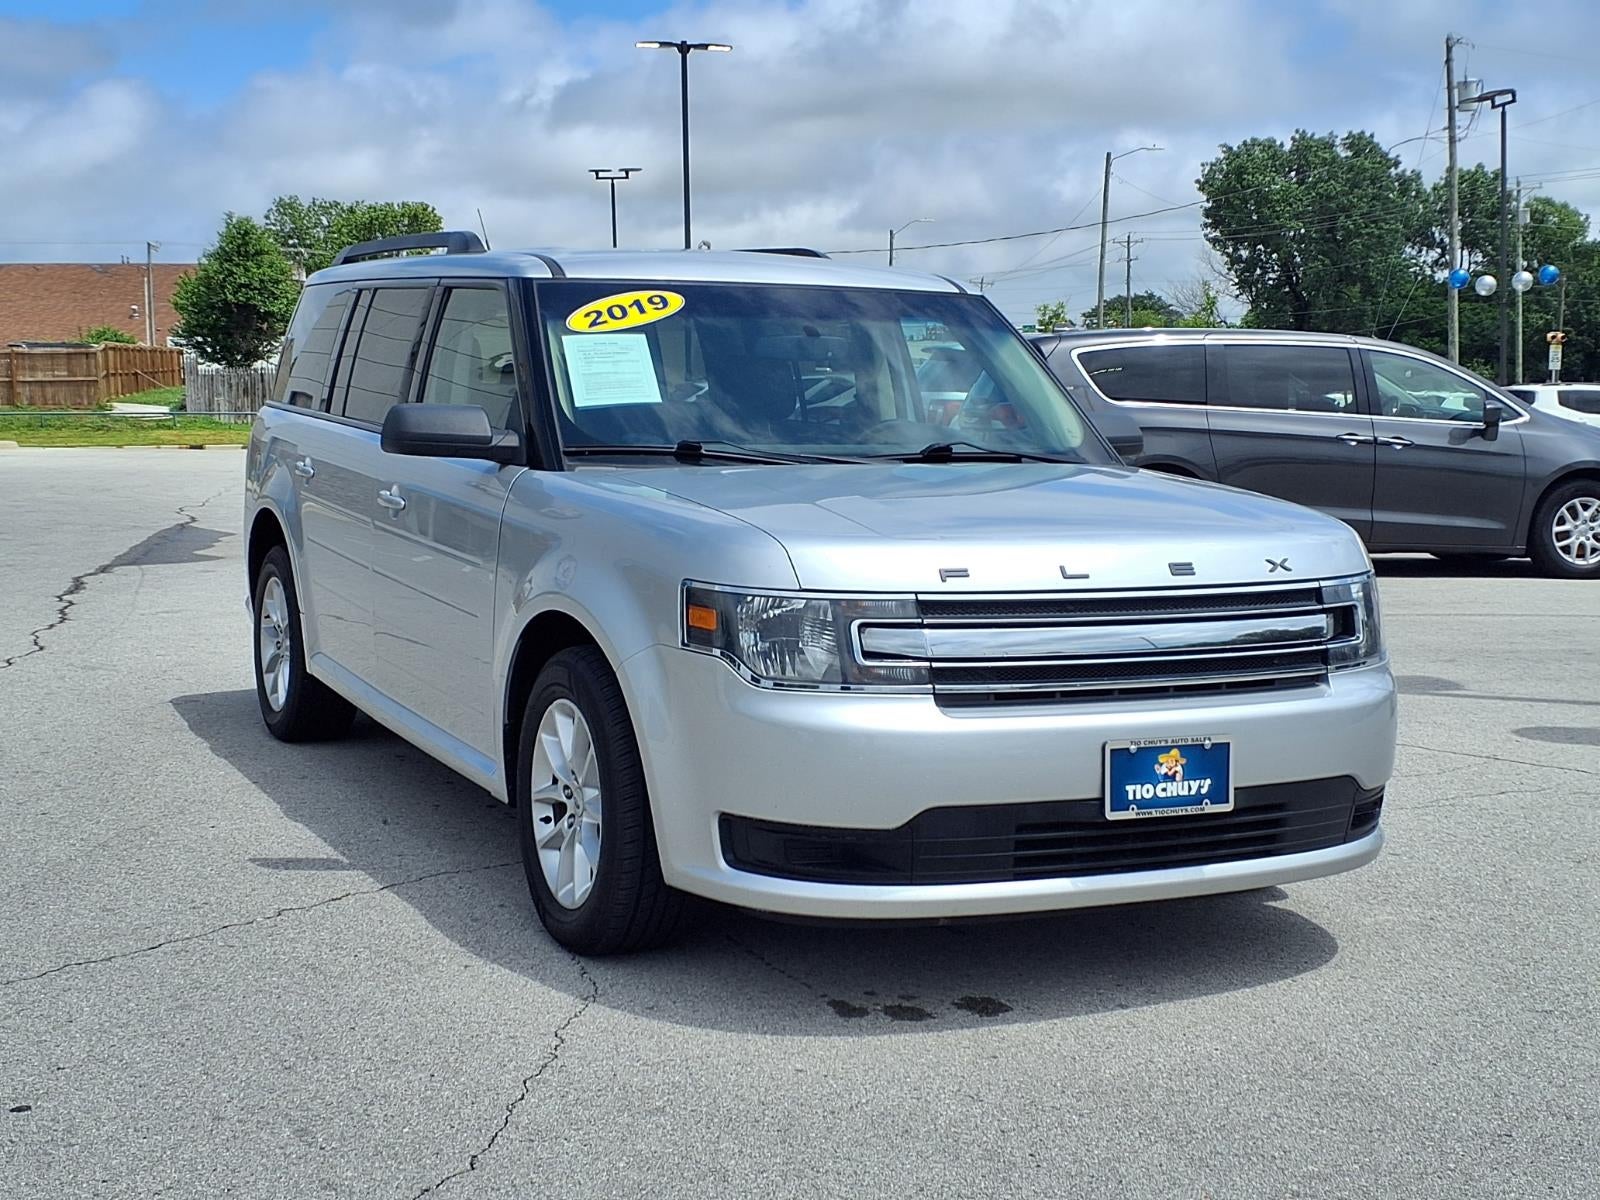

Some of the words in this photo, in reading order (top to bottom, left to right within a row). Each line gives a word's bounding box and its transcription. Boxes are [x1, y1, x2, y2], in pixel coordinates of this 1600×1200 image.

[584, 294, 669, 328] 2019
[939, 557, 1292, 582] FLEX
[1125, 784, 1155, 800] TIO
[1155, 778, 1212, 797] CHUY'S
